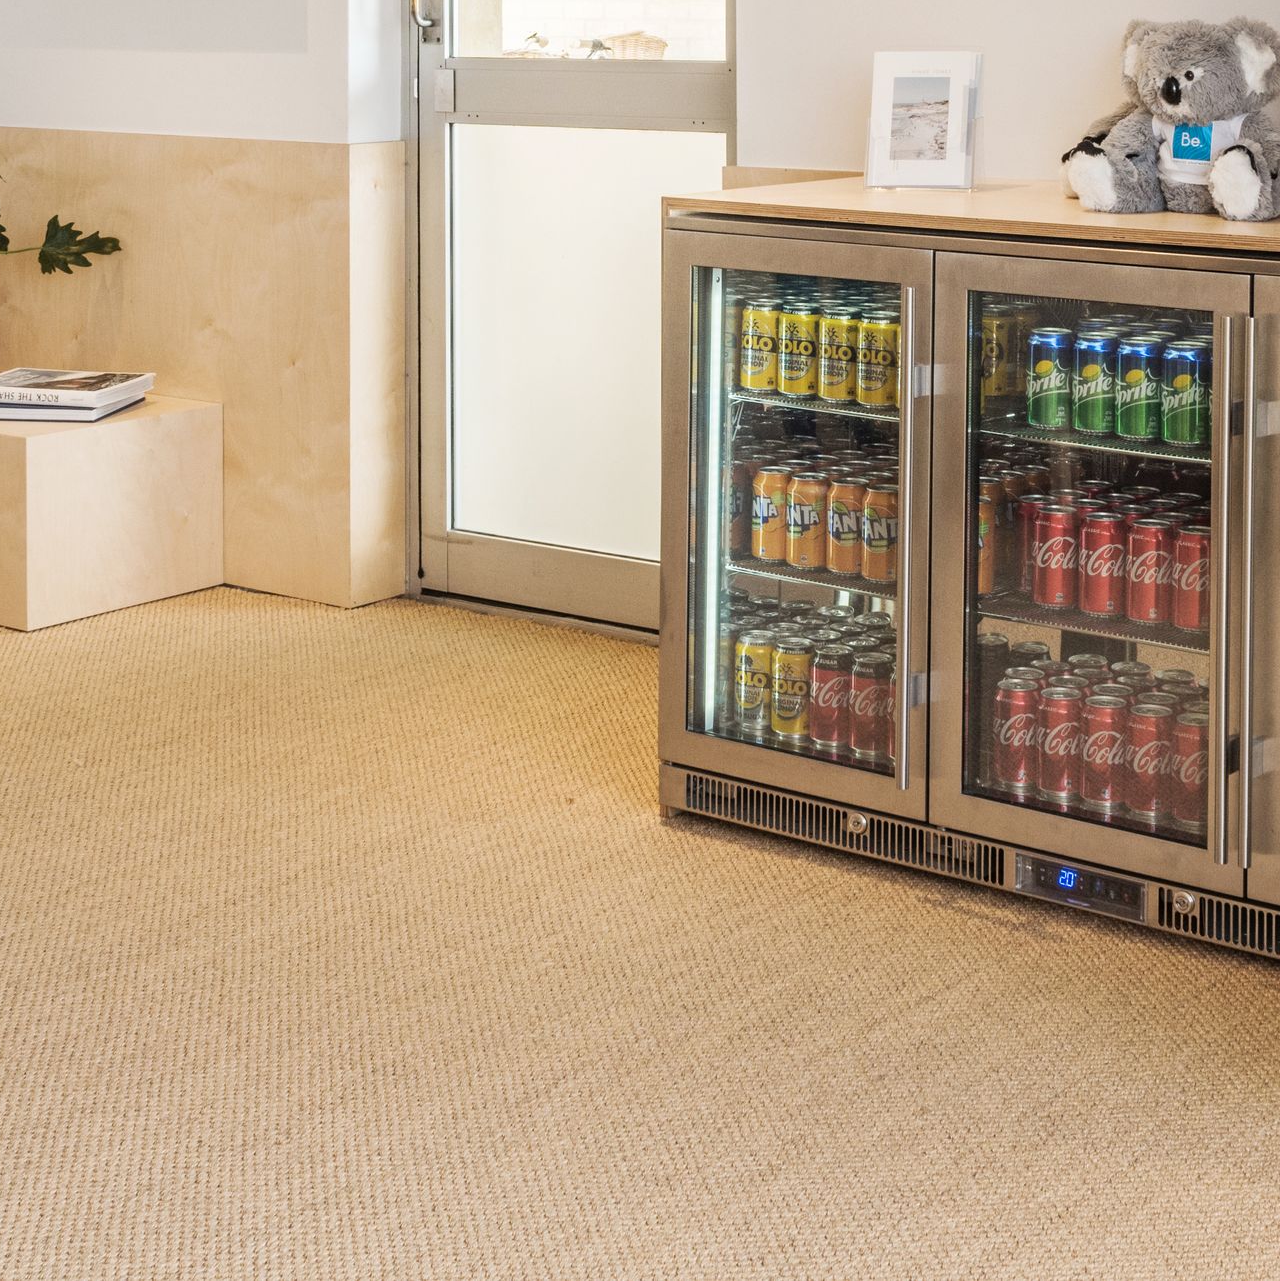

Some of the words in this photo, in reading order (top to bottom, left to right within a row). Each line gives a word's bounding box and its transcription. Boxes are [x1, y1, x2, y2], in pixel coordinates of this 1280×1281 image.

[1181, 132, 1204, 148] Be.
[742, 334, 772, 352] OLO
[1026, 370, 1066, 396] Sprite
[1072, 373, 1113, 401] Sprite
[1115, 378, 1157, 405] Sprite
[18, 392, 32, 400] THE
[37, 393, 59, 403] ROCK
[1161, 384, 1204, 412] Sprite
[752, 496, 777, 517] NTA
